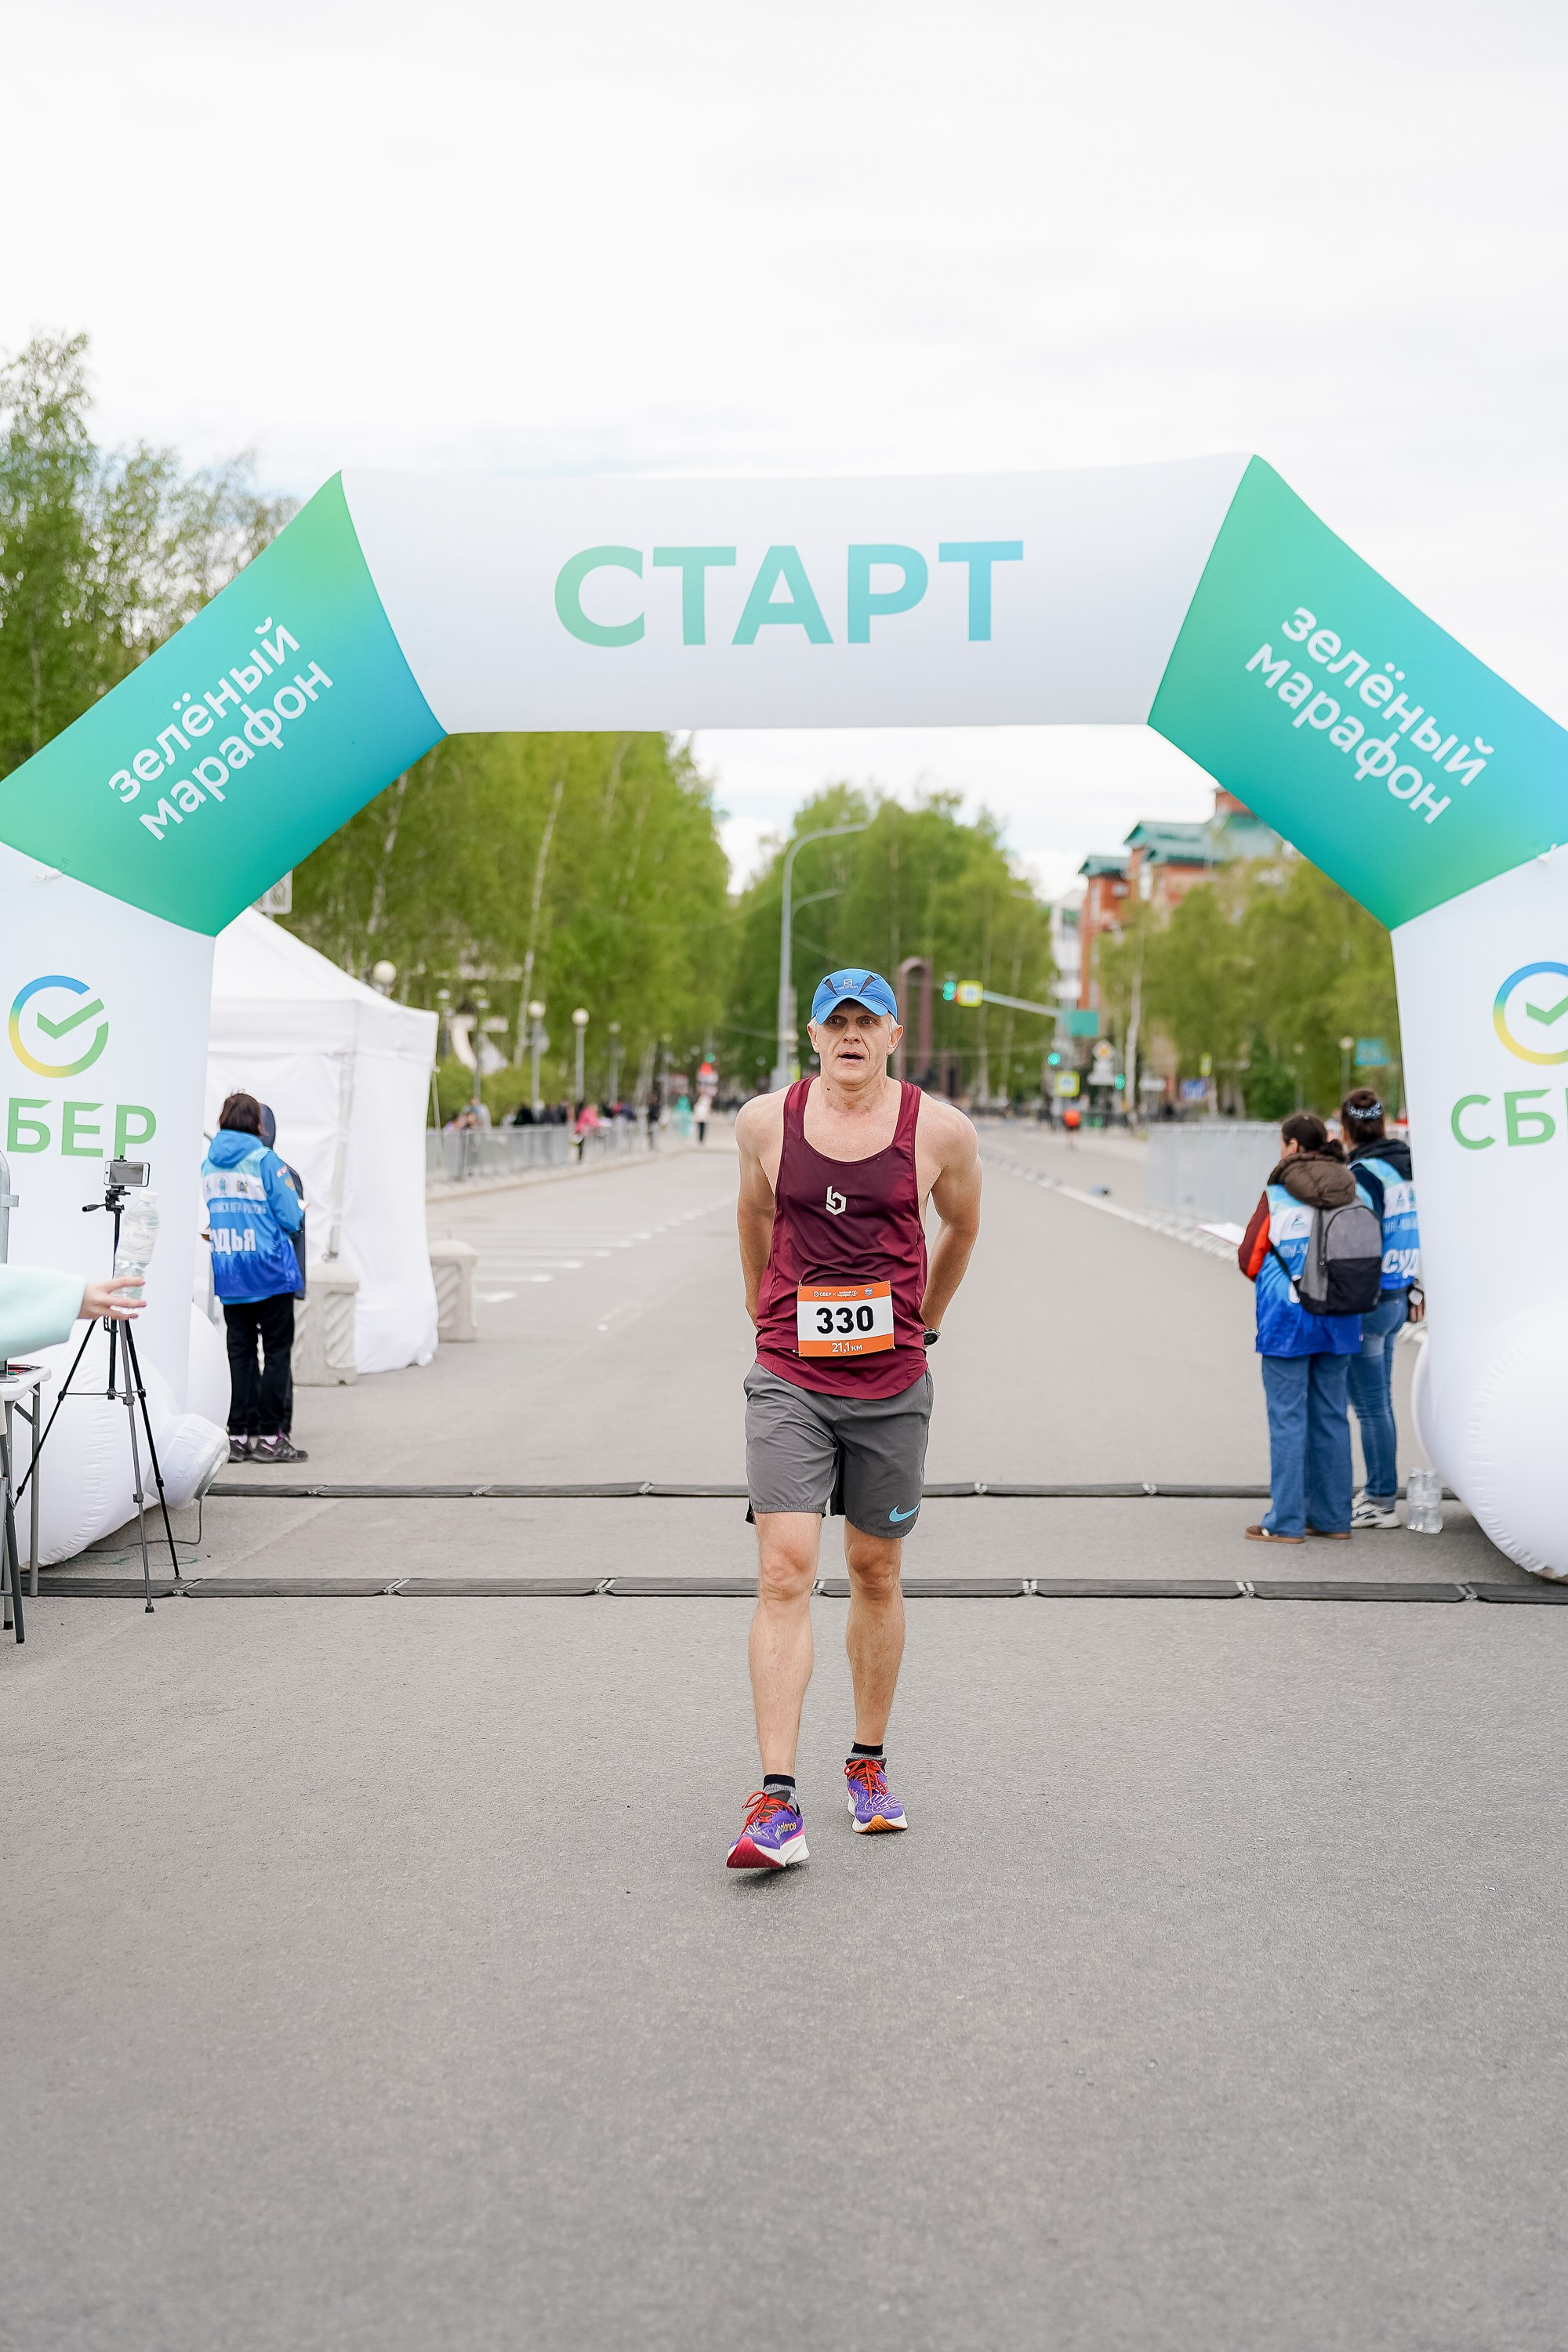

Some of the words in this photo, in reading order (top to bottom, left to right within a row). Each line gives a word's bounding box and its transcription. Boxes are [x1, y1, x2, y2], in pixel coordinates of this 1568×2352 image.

[554, 540, 1023, 648] СТАРТ
[107, 615, 300, 804] зелёный
[1244, 642, 1452, 825] марафон
[1281, 607, 1495, 787] зелёный
[138, 660, 334, 841] марафон
[7, 1098, 156, 1158] БЕР
[1451, 1087, 1568, 1150] СБ
[210, 1227, 257, 1256] УДЬЯ
[816, 1305, 874, 1334] 330
[831, 1341, 851, 1354] 21,1
